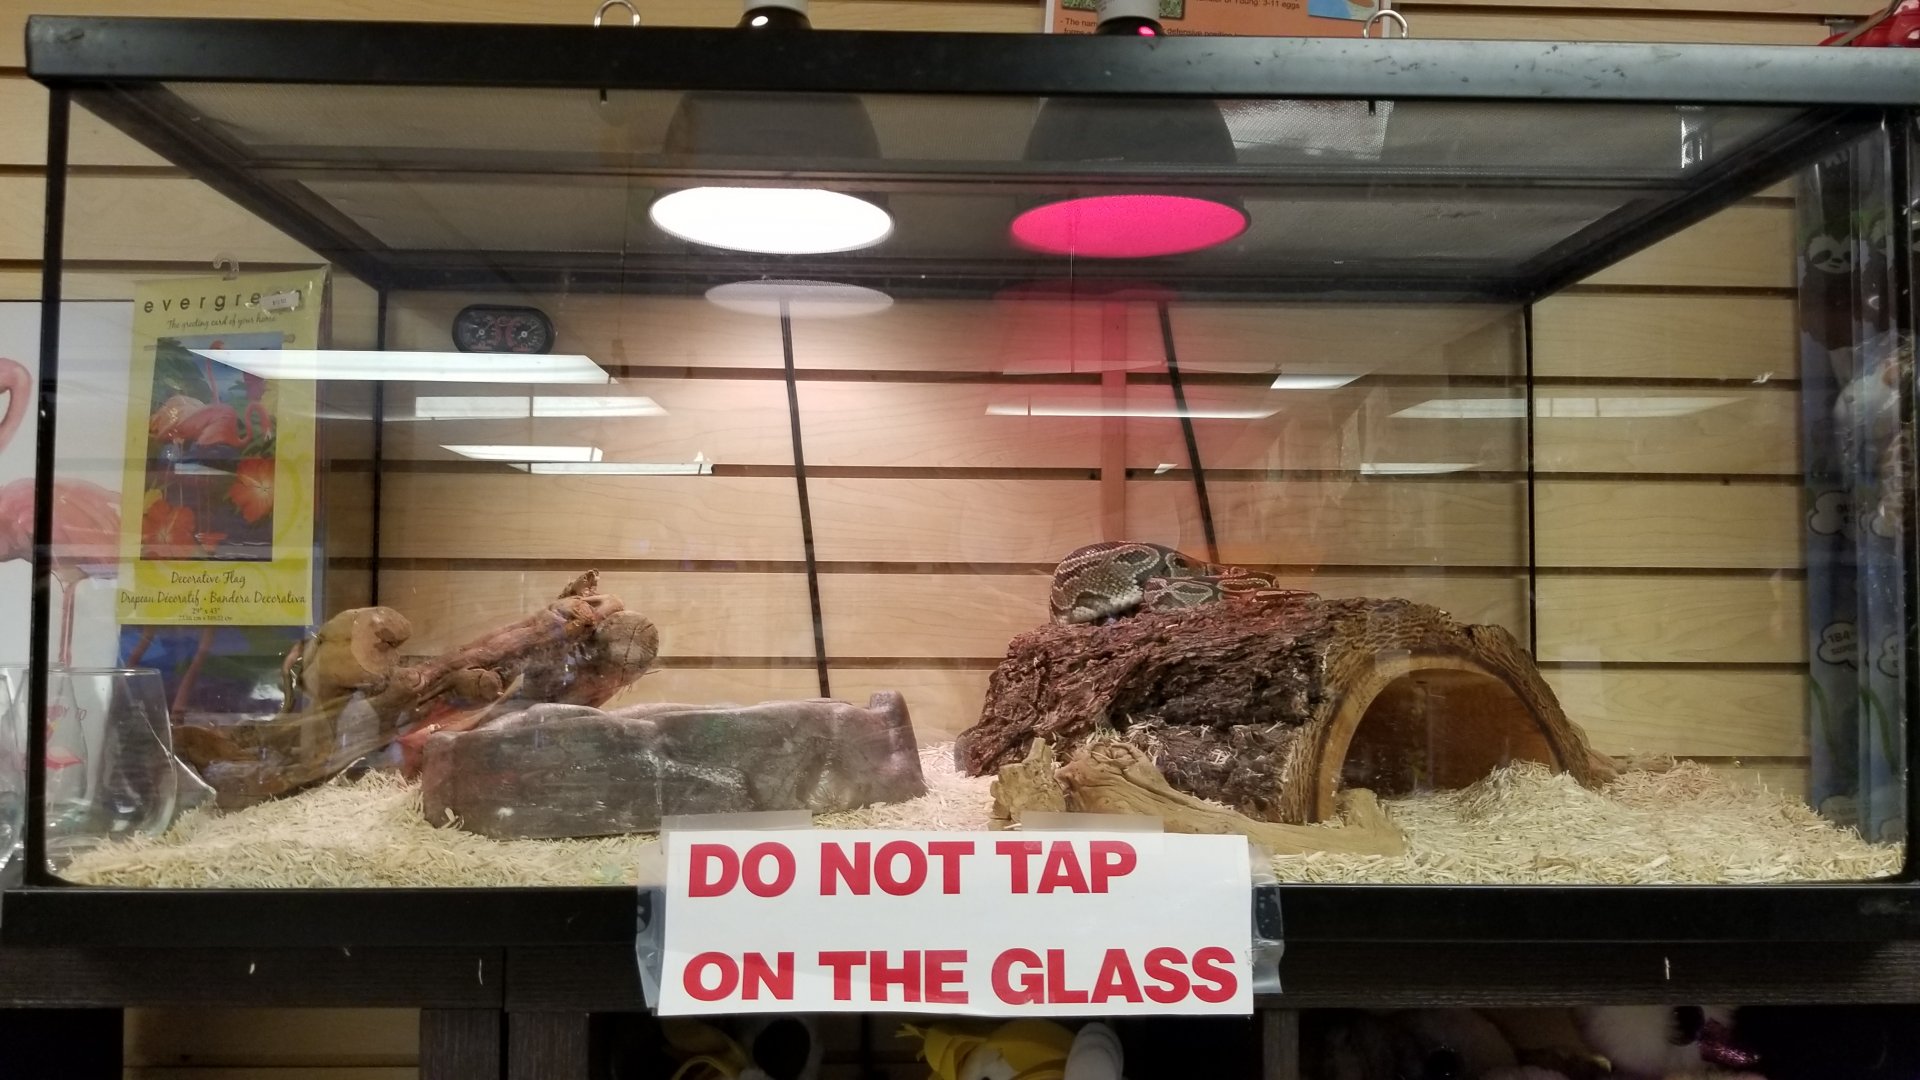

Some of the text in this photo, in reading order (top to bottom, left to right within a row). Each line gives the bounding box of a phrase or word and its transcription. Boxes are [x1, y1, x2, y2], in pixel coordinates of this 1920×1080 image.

[1282, 2, 1301, 11] eggs
[1065, 17, 1080, 26] The
[144, 289, 303, 314] evergren
[167, 318, 181, 329] The
[181, 317, 210, 331] greeting
[211, 315, 227, 328] card
[227, 314, 236, 329] of
[237, 316, 255, 330] your
[171, 569, 246, 588] Decorative Flag
[120, 592, 154, 609] Drapeau
[210, 590, 250, 604] Bandera
[253, 590, 306, 604] Decorativa
[688, 840, 1137, 898] DO NOT TAP
[683, 946, 1238, 1005] ON THE GLASS
